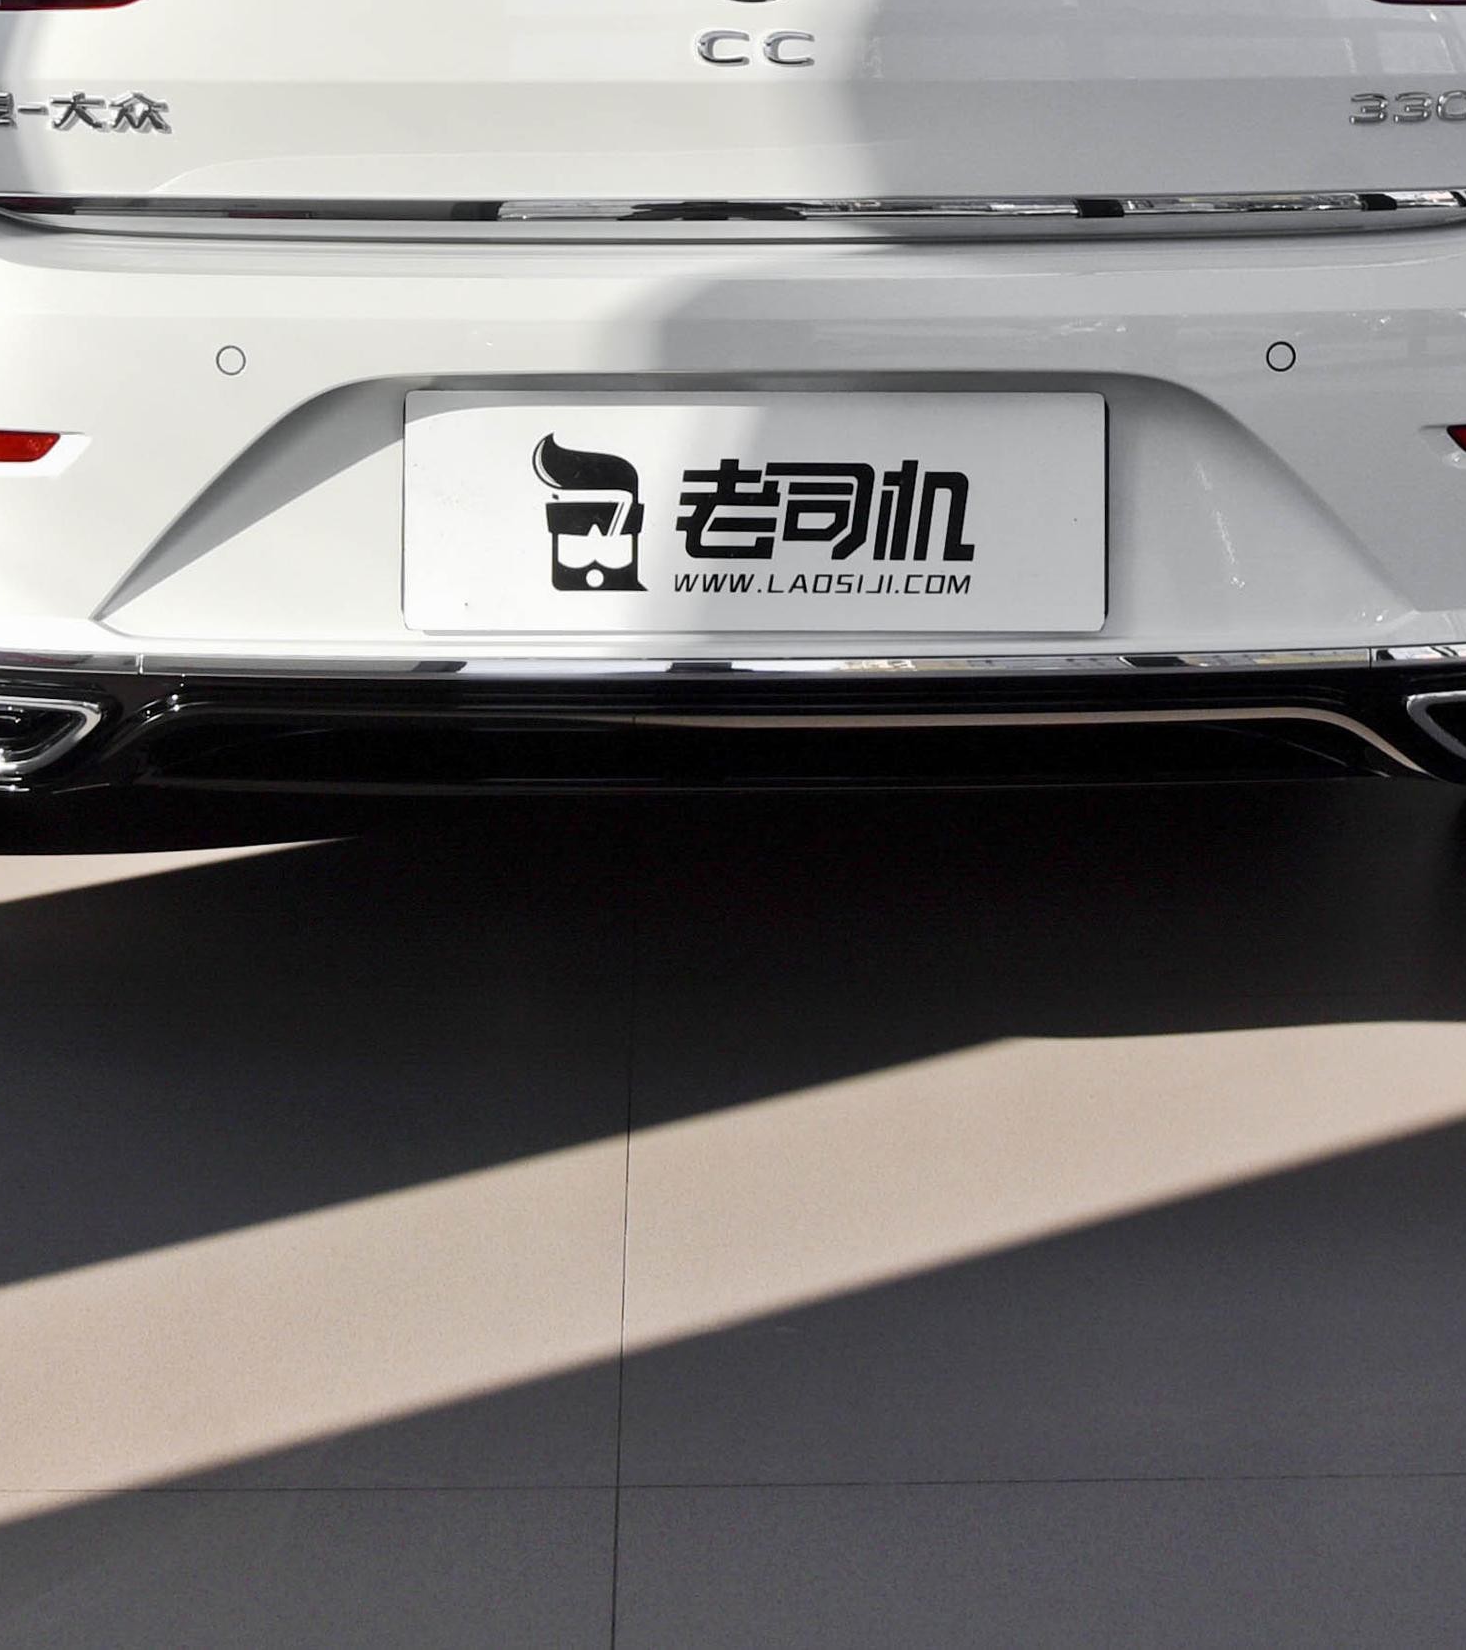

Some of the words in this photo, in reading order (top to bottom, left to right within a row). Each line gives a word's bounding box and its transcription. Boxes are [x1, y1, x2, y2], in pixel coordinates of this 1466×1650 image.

[697, 30, 815, 67] CC
[676, 459, 975, 561] 老司机
[673, 573, 972, 595] WWW.LAOSIJI.COM
